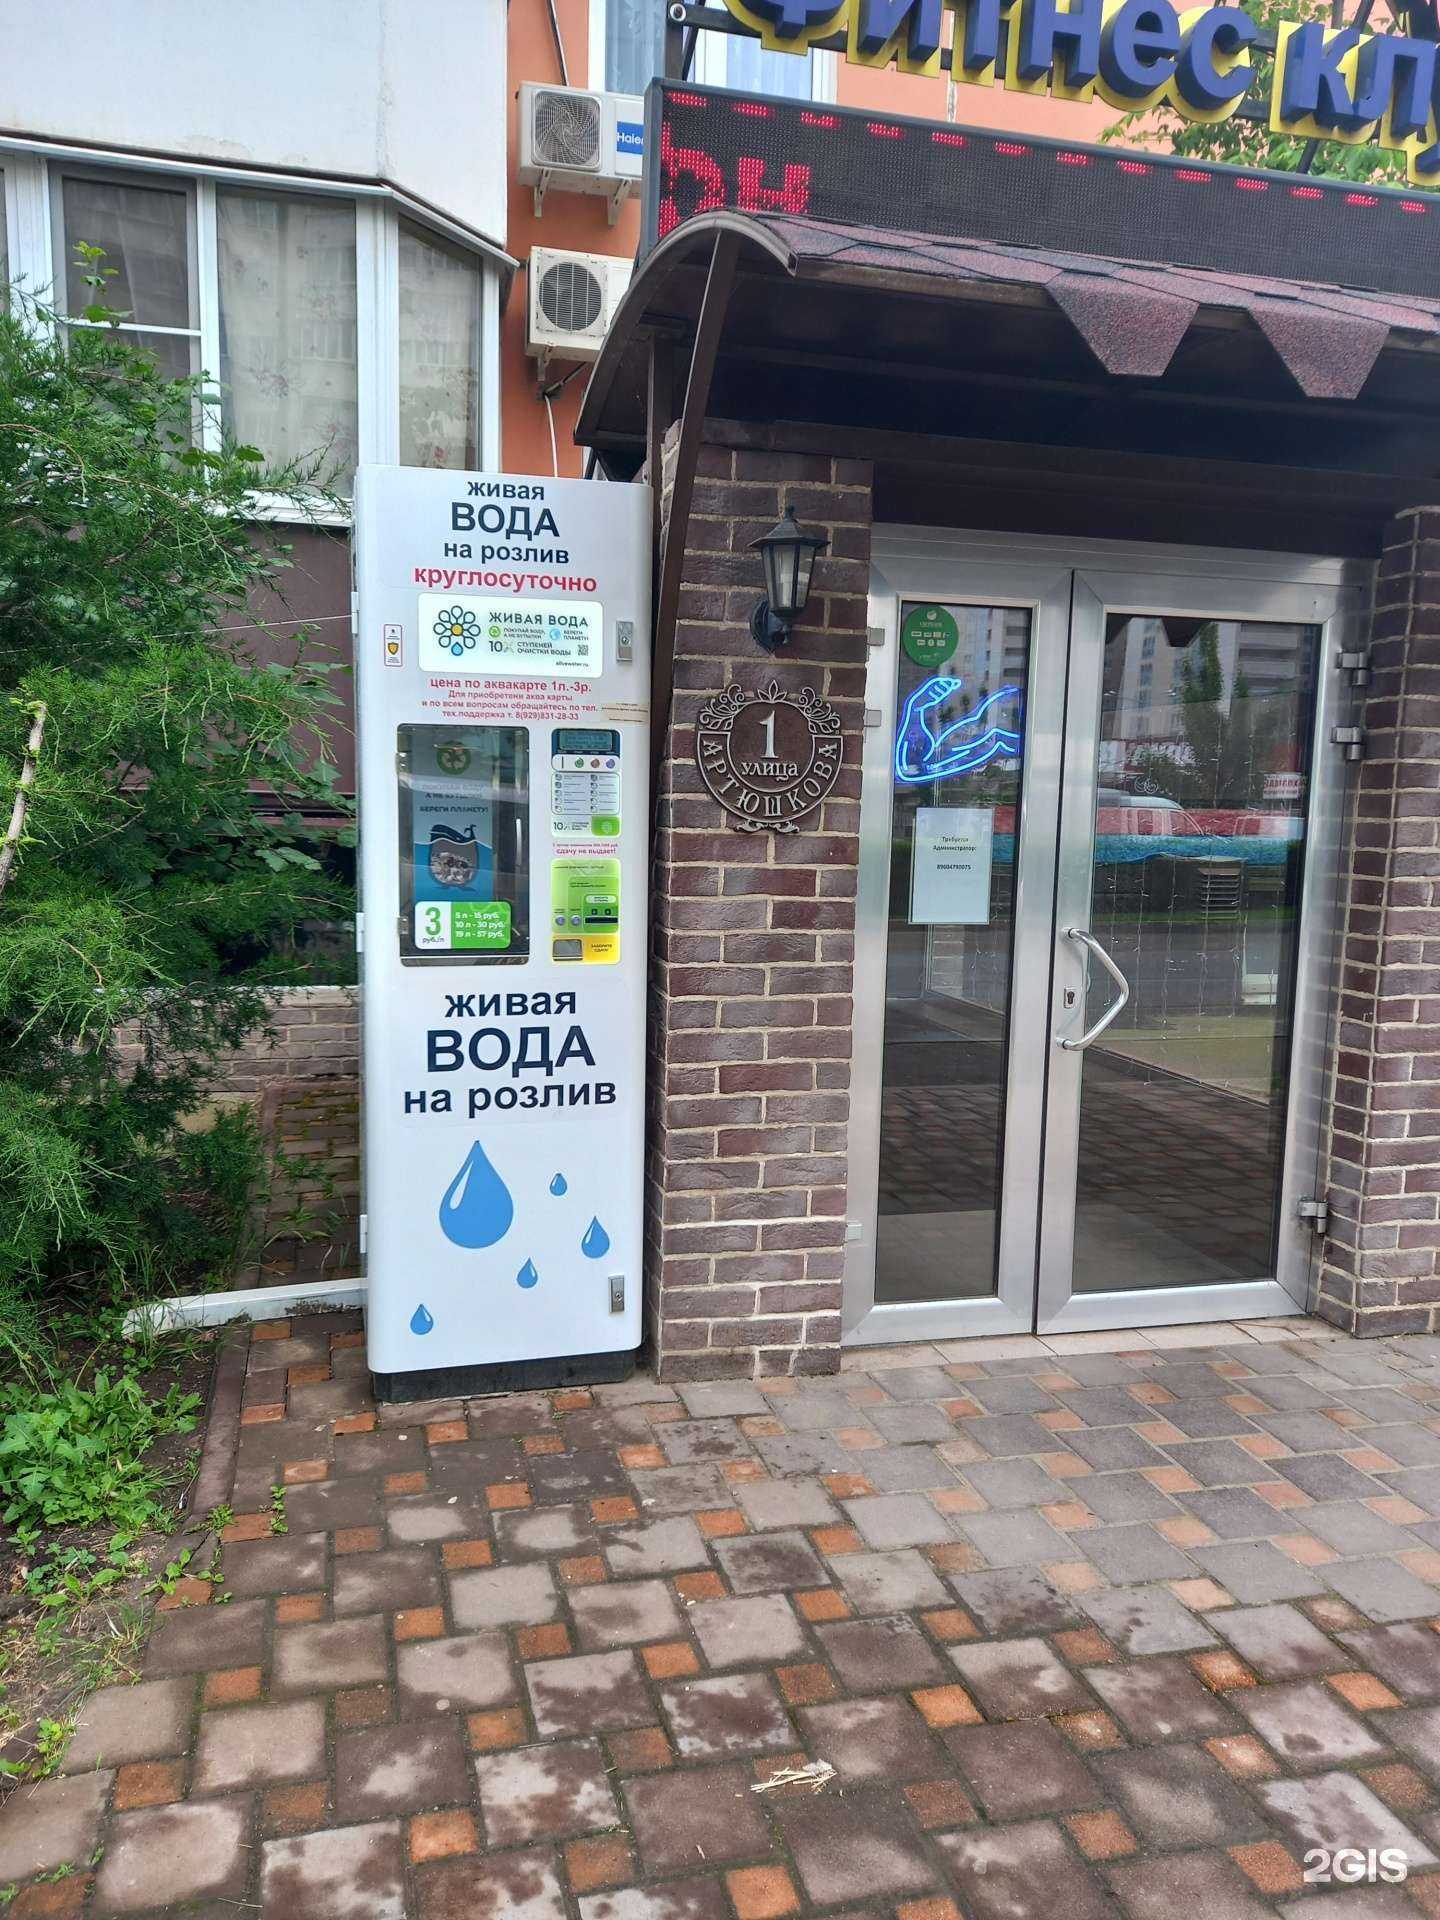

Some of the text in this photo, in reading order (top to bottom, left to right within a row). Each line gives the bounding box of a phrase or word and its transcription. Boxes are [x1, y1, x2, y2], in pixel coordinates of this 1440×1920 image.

[1277, 20, 1440, 176] кл
[467, 481, 545, 500] живая
[451, 502, 560, 541] ВОДА
[444, 542, 569, 564] на розлив
[414, 567, 597, 593] круглосуточно
[489, 611, 588, 628] ЖИВАЯ ВОДА
[489, 641, 503, 652] 10
[430, 678, 463, 690] цена
[465, 680, 481, 689] по
[484, 680, 547, 693] аквакарте
[759, 710, 779, 759] 1
[741, 761, 798, 781] улица
[425, 907, 441, 936] 3
[445, 992, 576, 1017] живая
[427, 1025, 596, 1078] ВОДА
[404, 1082, 617, 1119] на розлив
